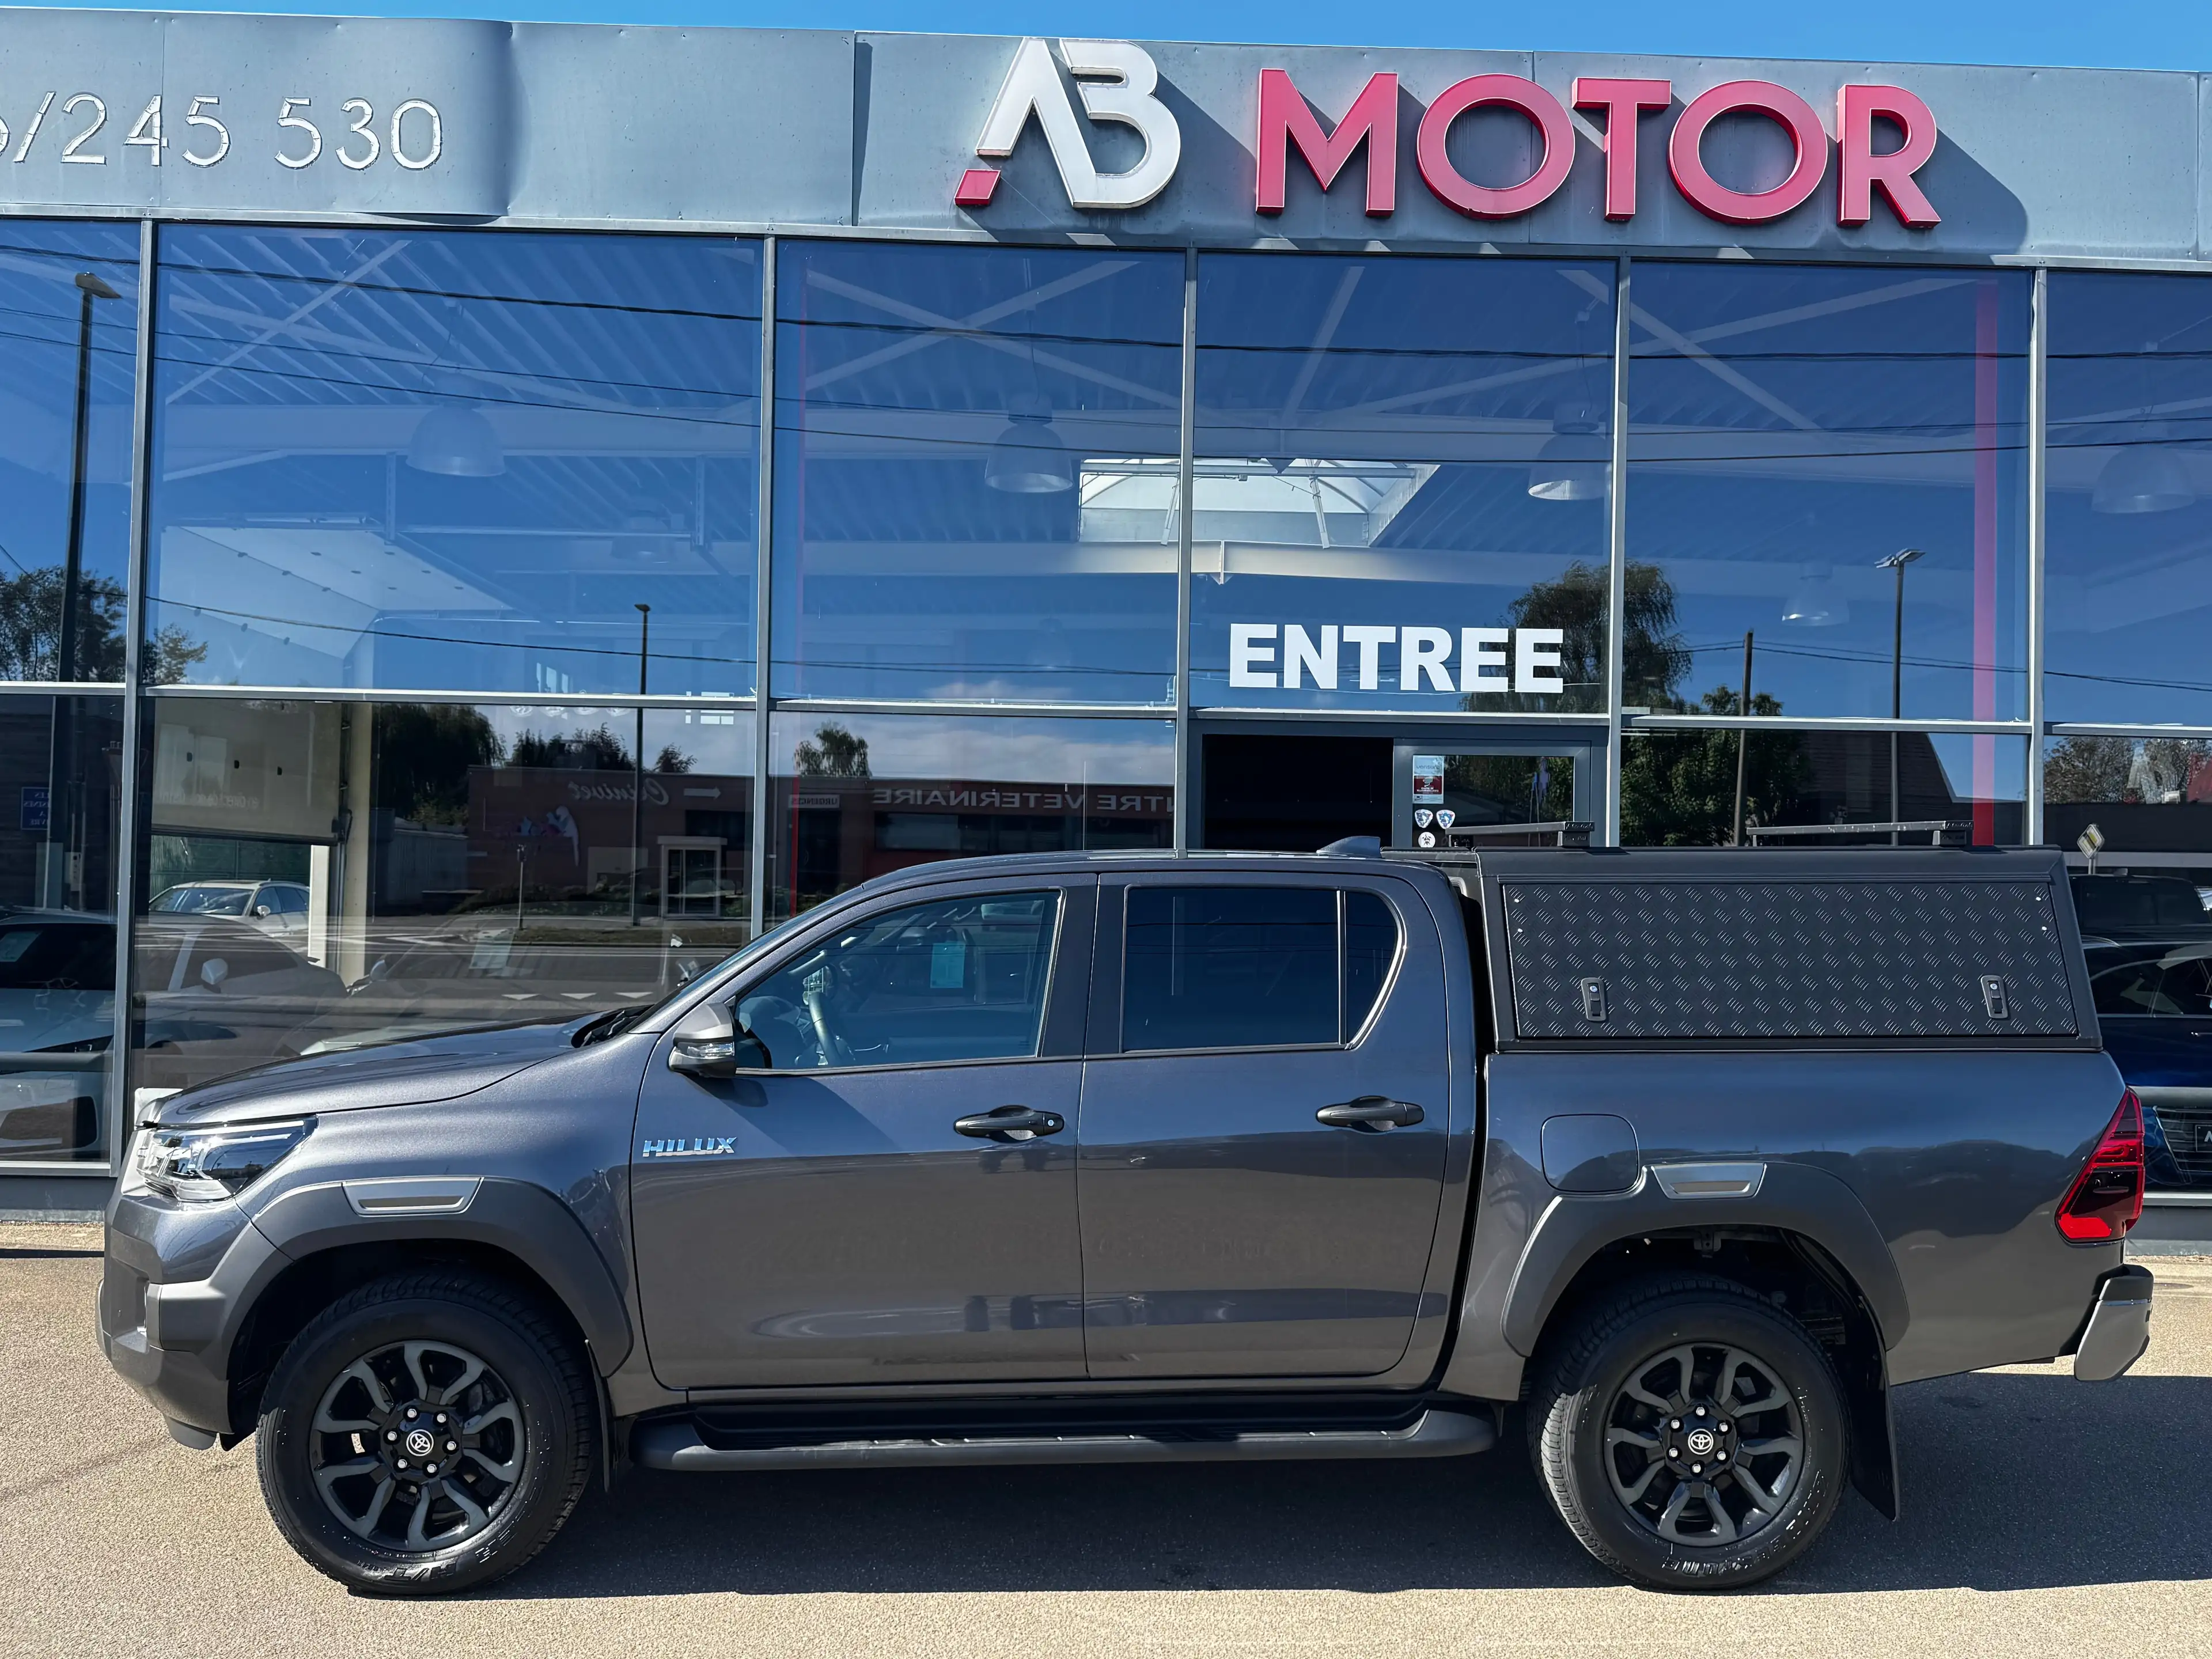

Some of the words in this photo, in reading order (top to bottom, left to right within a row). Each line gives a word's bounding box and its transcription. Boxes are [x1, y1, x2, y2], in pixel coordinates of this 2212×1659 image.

[274, 97, 442, 171] 530
[955, 36, 1181, 209] AB
[1255, 67, 1942, 229] MOTOR
[1229, 623, 1563, 694] ENTREE
[642, 1137, 737, 1157] HILUX
